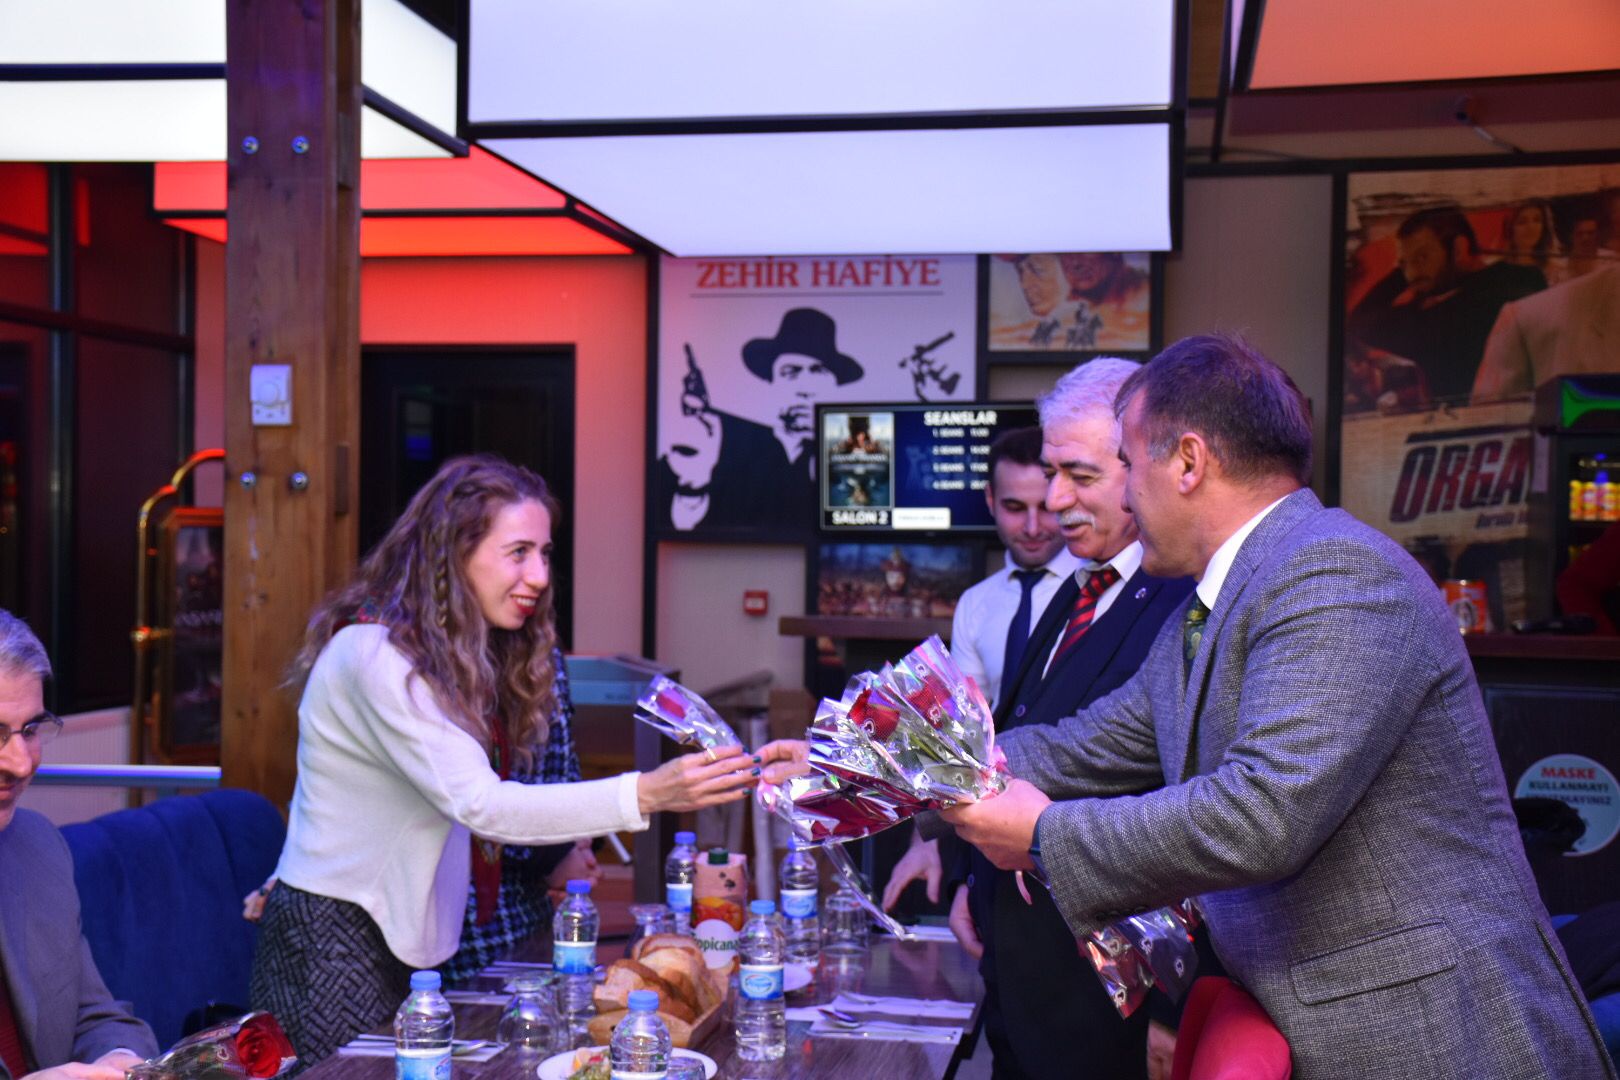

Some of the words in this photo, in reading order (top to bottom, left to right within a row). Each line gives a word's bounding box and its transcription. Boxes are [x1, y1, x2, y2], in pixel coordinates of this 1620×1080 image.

[696, 256, 799, 288] ZEHİR
[811, 254, 942, 287] HAFİYE
[923, 411, 997, 426] SEANSLAR
[832, 510, 877, 525] SALON
[878, 510, 889, 525] 2
[1541, 767, 1595, 779] MASKE
[1528, 781, 1609, 793] KULLANMAYI
